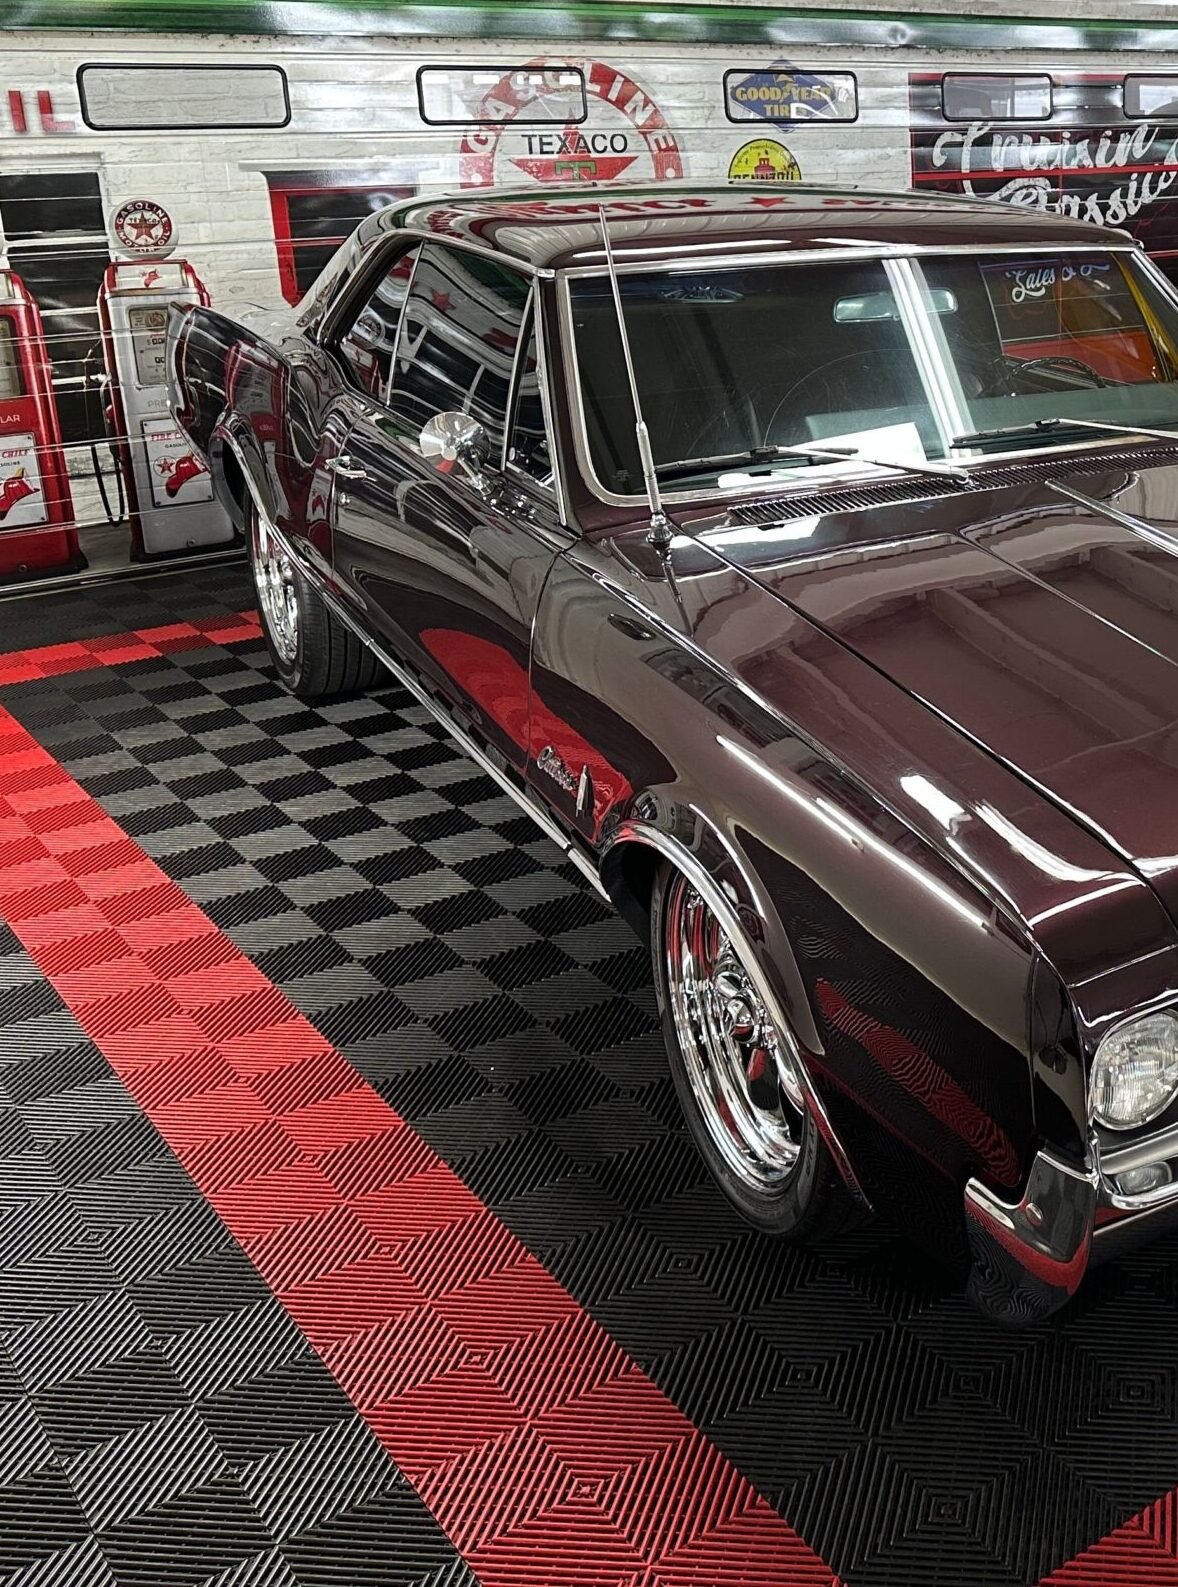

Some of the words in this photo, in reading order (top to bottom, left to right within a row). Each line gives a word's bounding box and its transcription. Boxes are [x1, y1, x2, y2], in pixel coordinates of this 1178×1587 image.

[8, 90, 76, 133] IL
[521, 133, 628, 155] TEXACO
[0, 415, 20, 423] LAR
